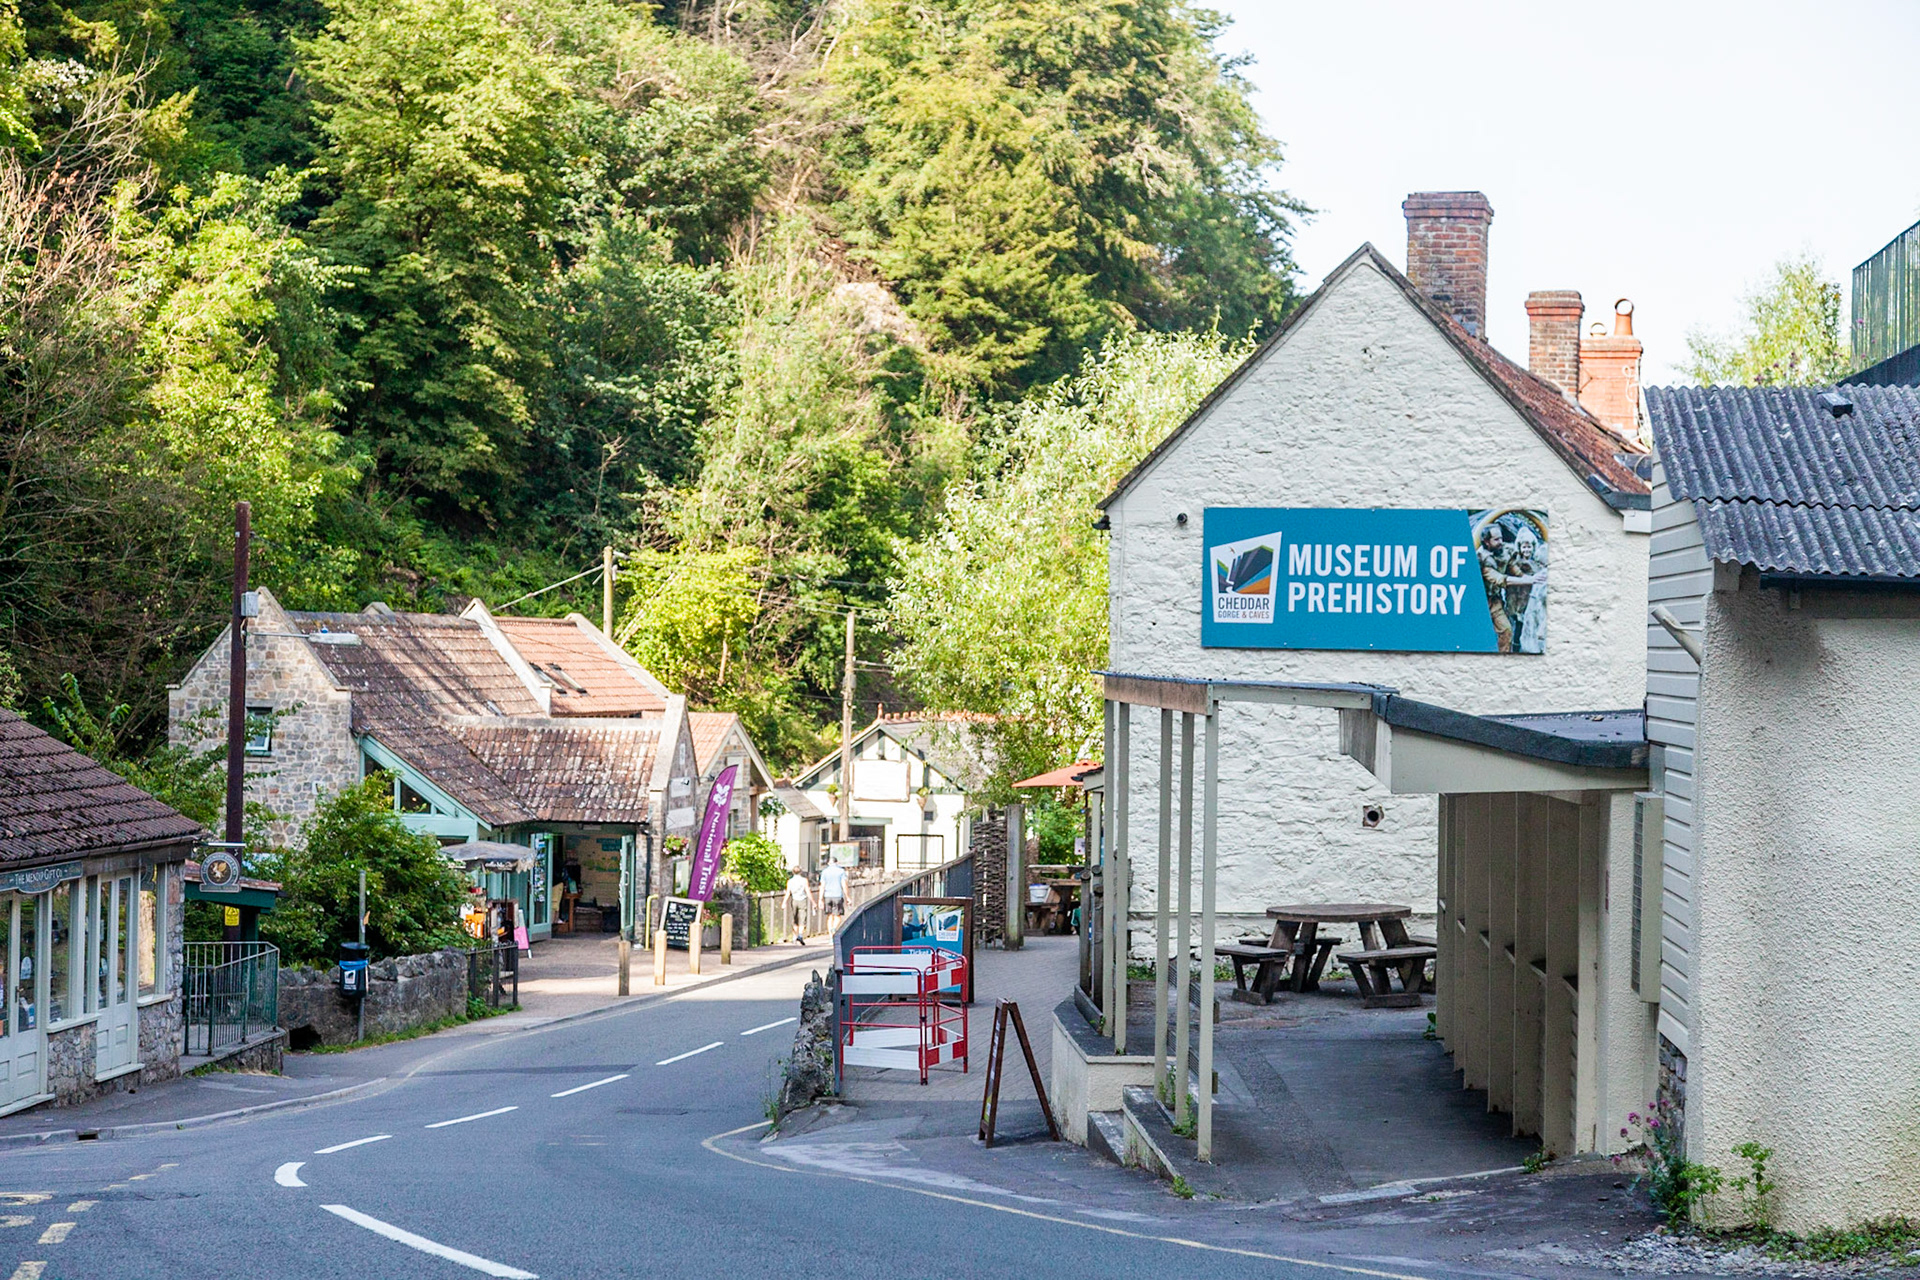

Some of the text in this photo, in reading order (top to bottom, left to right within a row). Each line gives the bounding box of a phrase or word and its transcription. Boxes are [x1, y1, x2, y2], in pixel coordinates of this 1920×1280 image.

[1288, 543, 1468, 578] MUSEUM OF
[1217, 610, 1270, 619] GORGE & CAVES
[1218, 597, 1270, 610] CHEDDAR
[1288, 582, 1467, 615] PREHISTORY
[698, 811, 721, 895] National Trust
